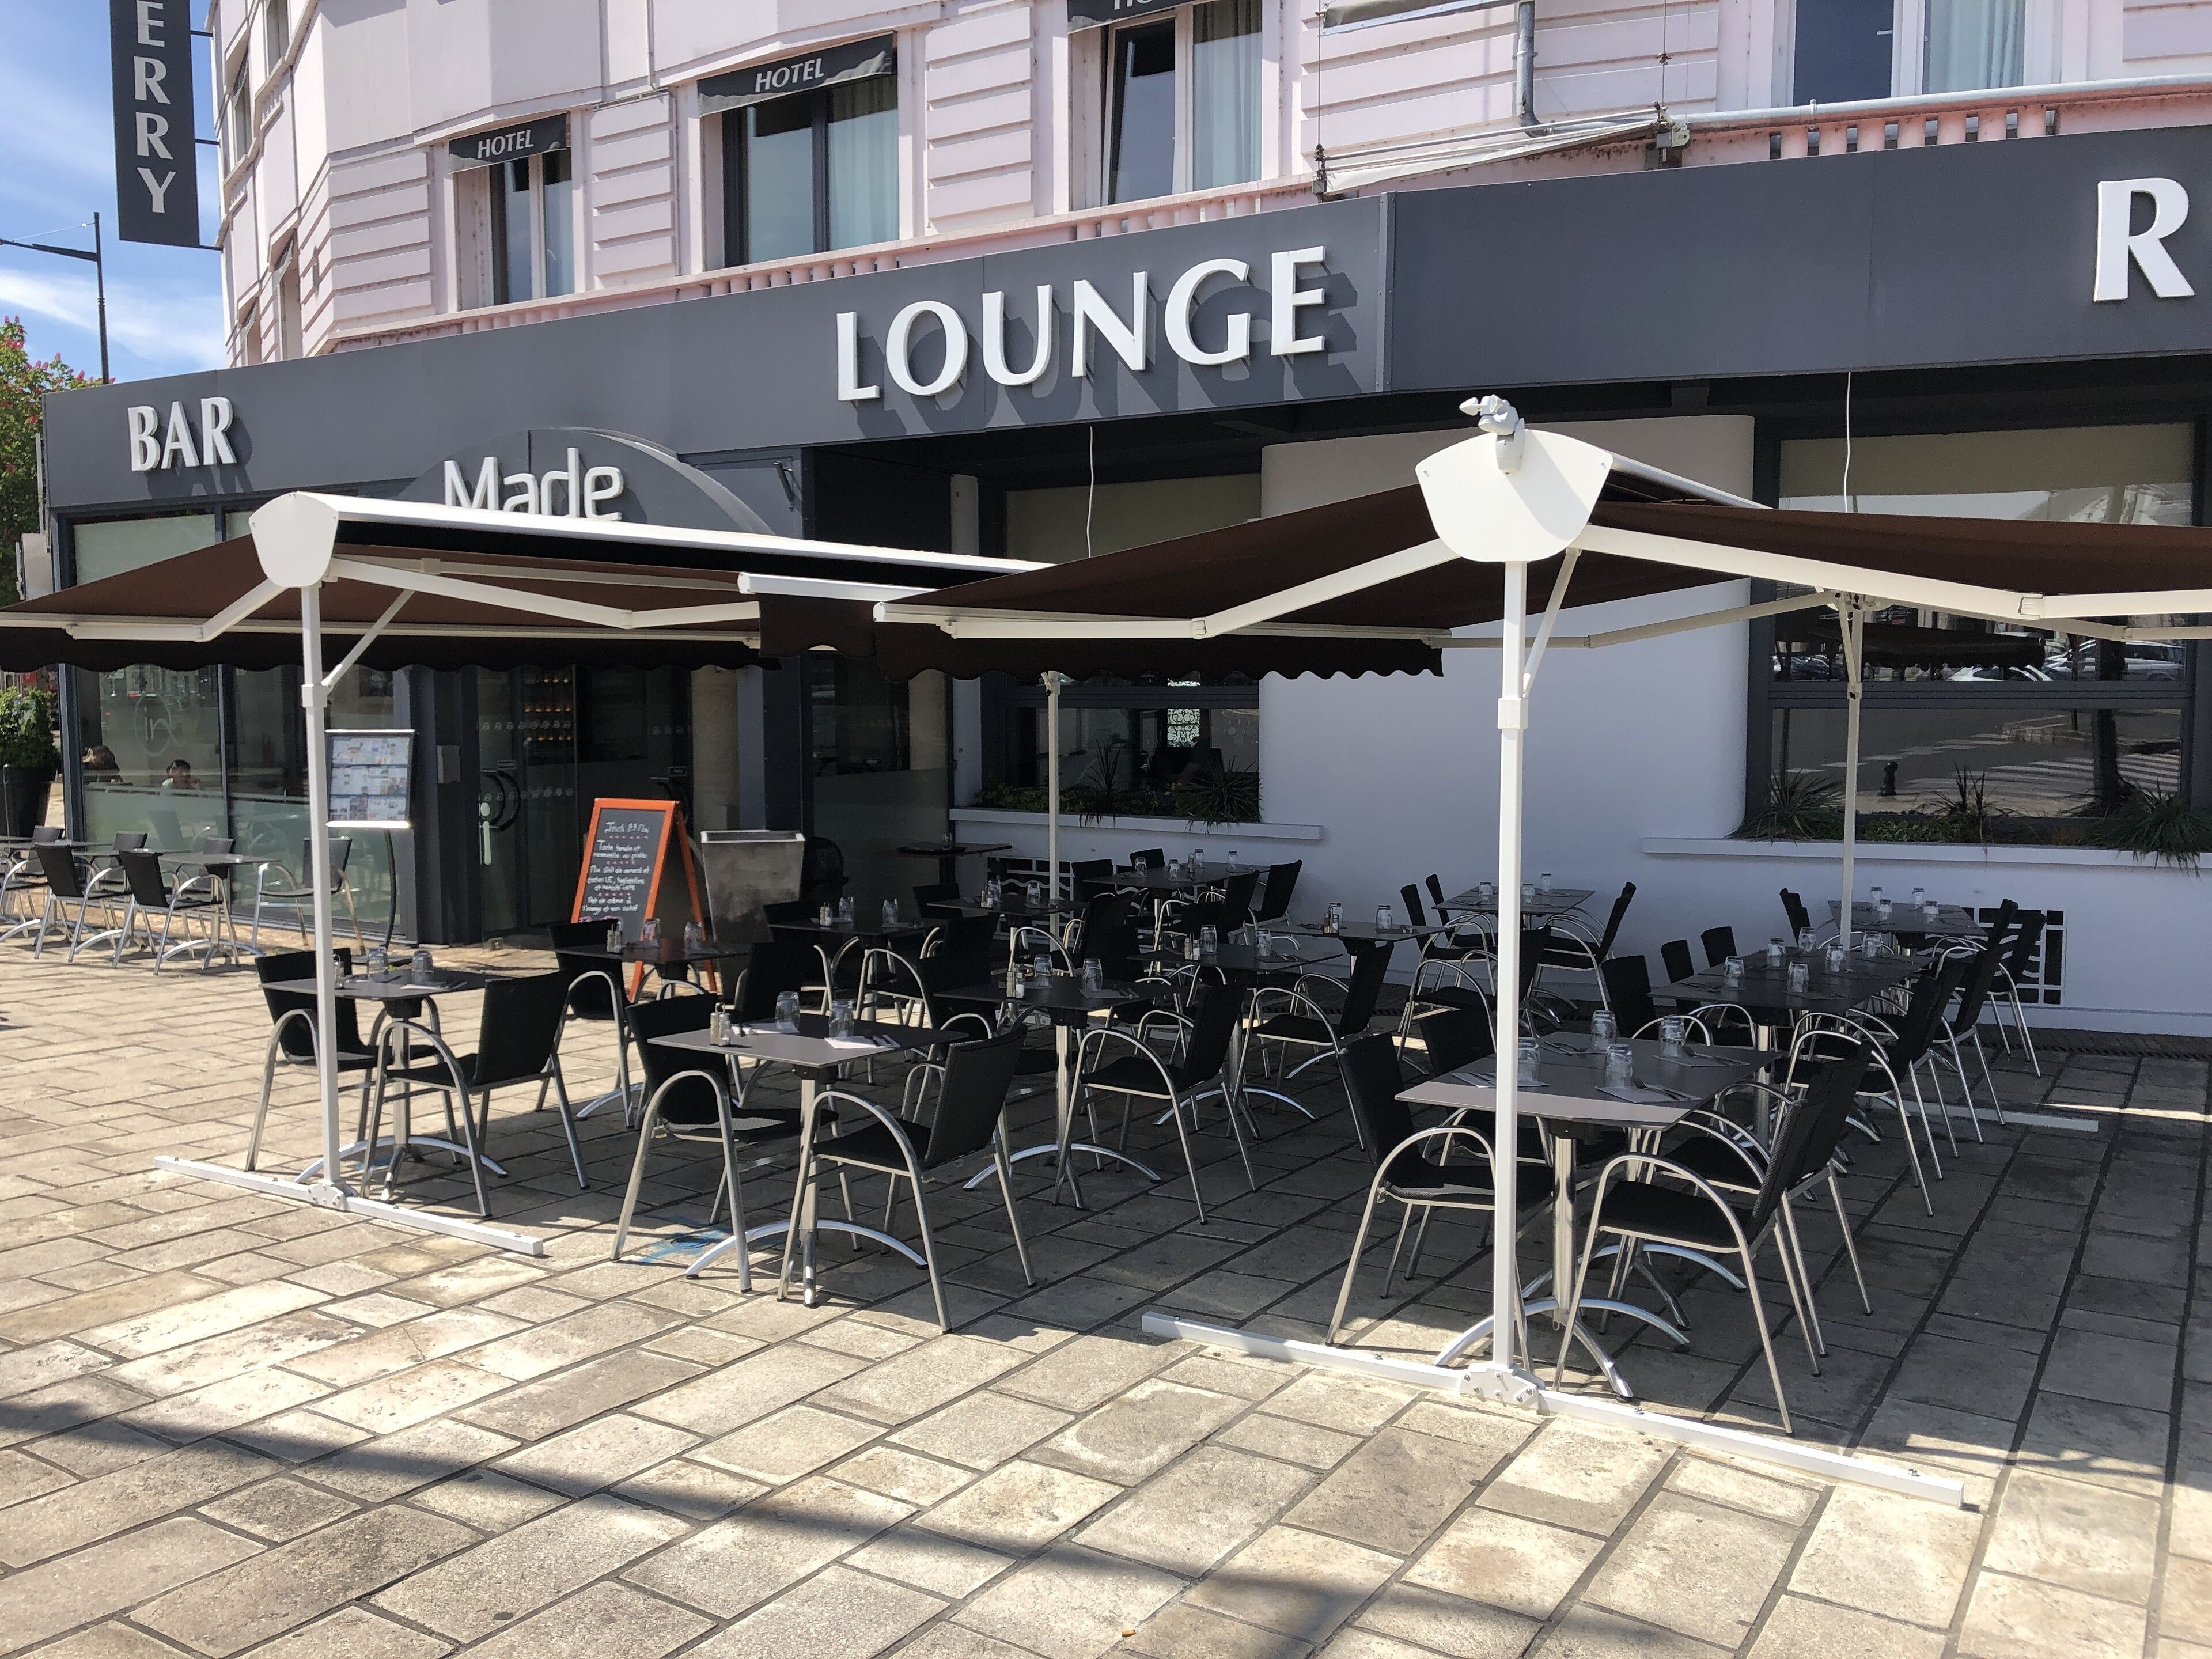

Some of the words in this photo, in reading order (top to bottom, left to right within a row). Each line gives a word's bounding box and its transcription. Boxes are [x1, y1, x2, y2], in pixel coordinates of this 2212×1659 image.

[134, 0, 176, 214] ERRY
[755, 58, 825, 93] HOTEL
[477, 128, 535, 158] HOTEL
[2093, 177, 2196, 302] R
[836, 245, 1326, 402] LOUNGE
[127, 396, 237, 472] BAR
[444, 447, 624, 521] Made
